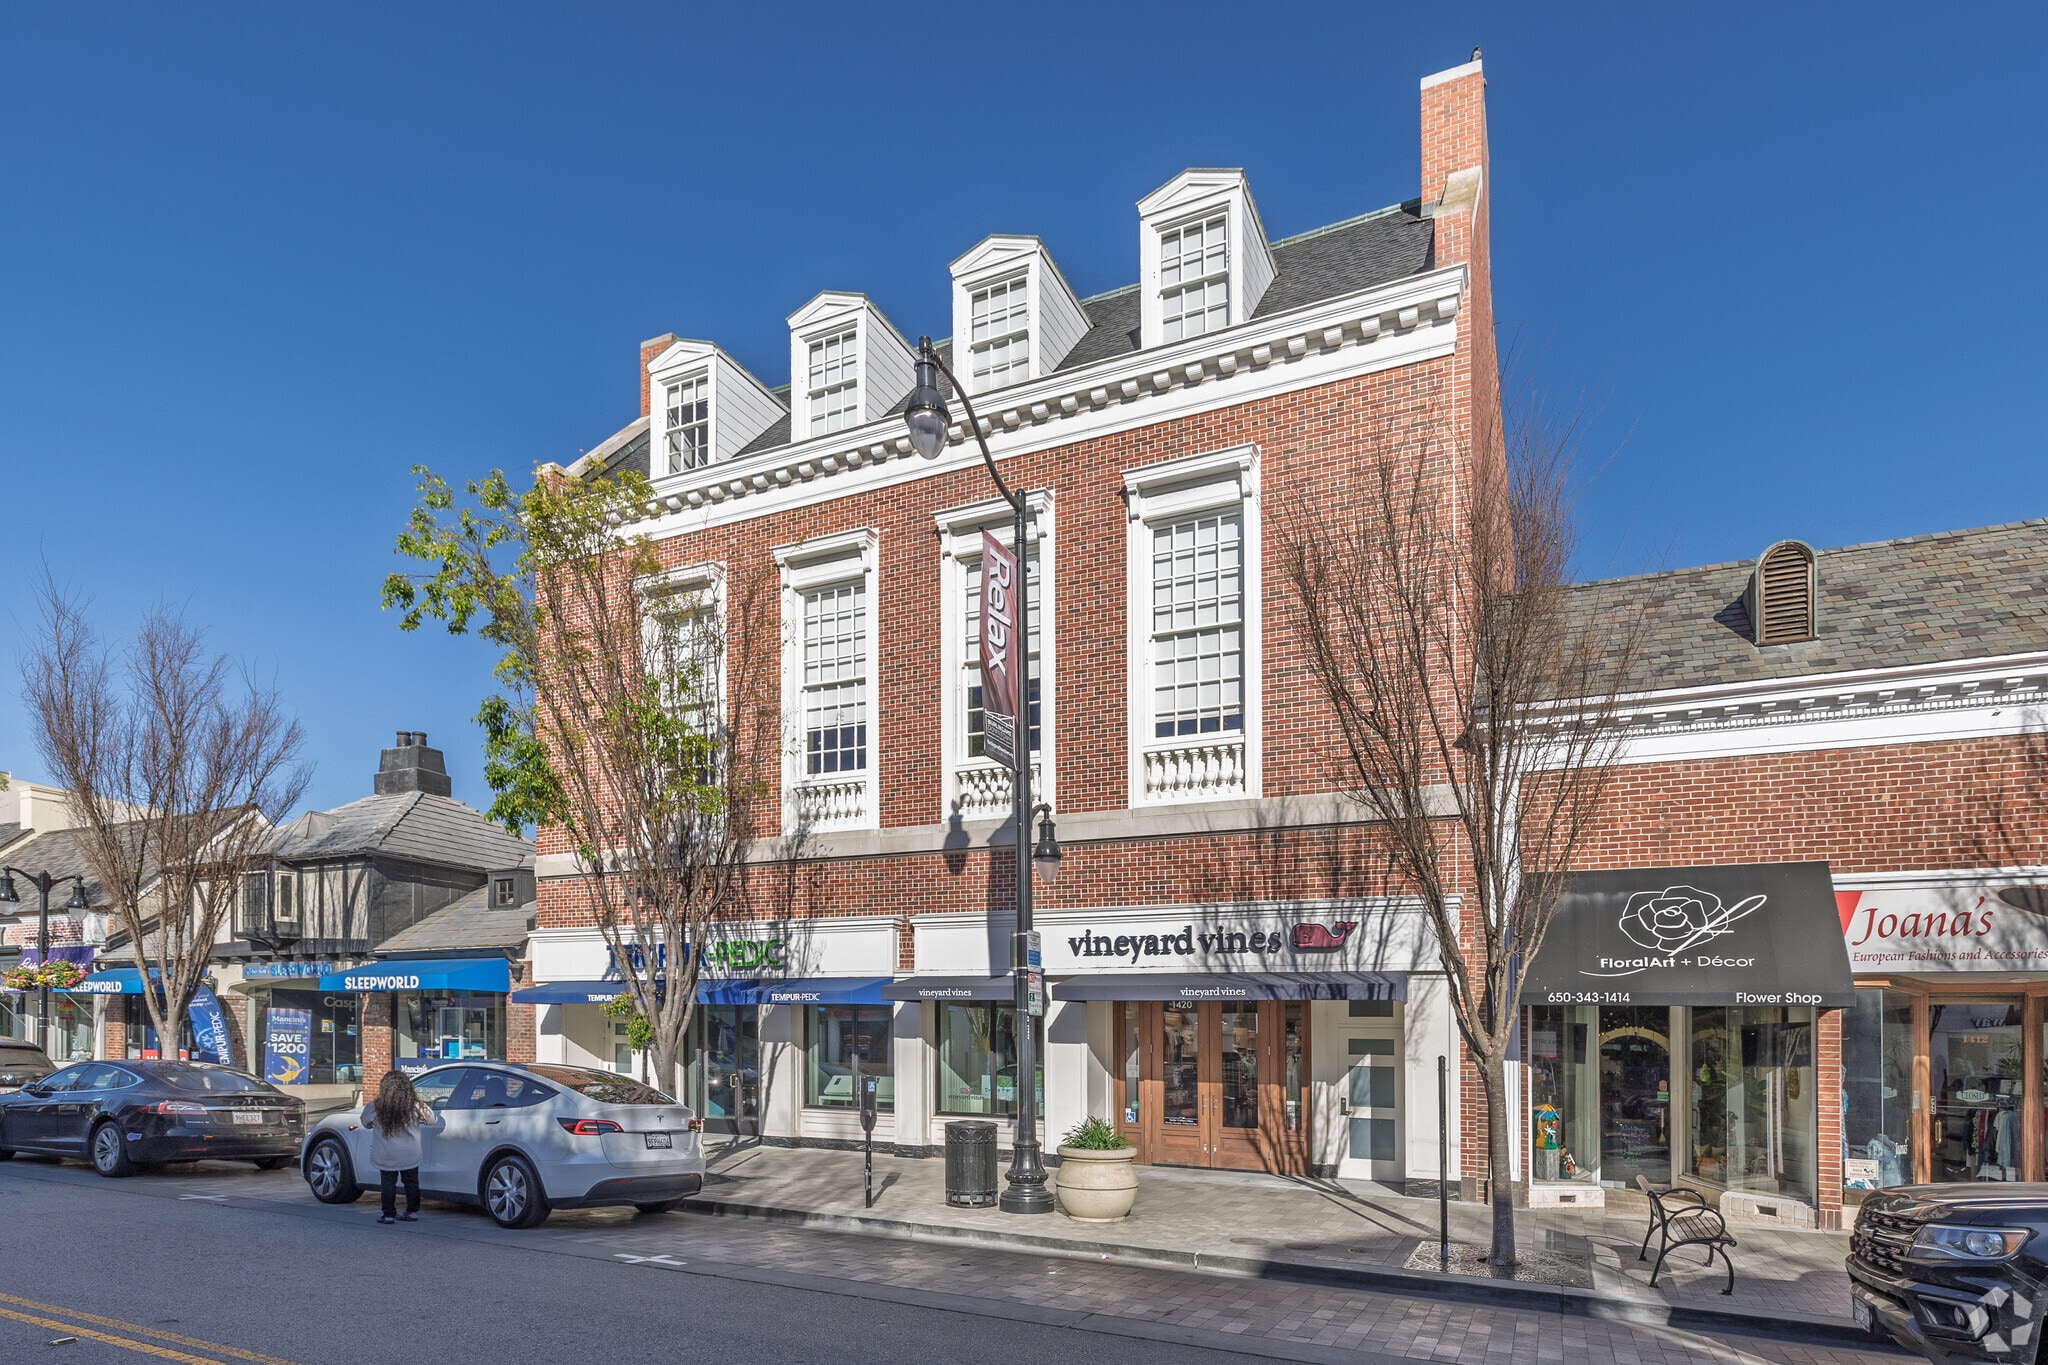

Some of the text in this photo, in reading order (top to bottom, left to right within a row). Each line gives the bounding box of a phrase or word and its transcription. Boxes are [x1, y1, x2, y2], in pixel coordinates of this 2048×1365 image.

[987, 547, 1012, 677] Relax
[1851, 896, 1994, 946] Joana's
[1067, 925, 1196, 965] vineyard
[1198, 926, 1282, 954] vines
[606, 939, 782, 968] TMPU-PEDIC
[1853, 948, 2048, 965] European Fashions and Accessories
[1600, 957, 1675, 969] FloralArt
[1697, 955, 1755, 967] Décor
[344, 975, 419, 990] SLEEPWORLD
[771, 992, 820, 1001] TEMPUR-PEDIC
[918, 988, 972, 998] vineyard vines
[1180, 987, 1246, 998] vineyard vines
[1548, 992, 1631, 1003] 650-343-1414
[1735, 992, 1822, 1005] Flower Shop
[323, 996, 362, 1012] Casp
[1172, 1001, 1193, 1009] 1420
[209, 1011, 230, 1065] EMPUR-PEDIC
[270, 1033, 302, 1043] SAVE
[1963, 1035, 1989, 1044] 1412
[1961, 1092, 1985, 1100] CLOSED
